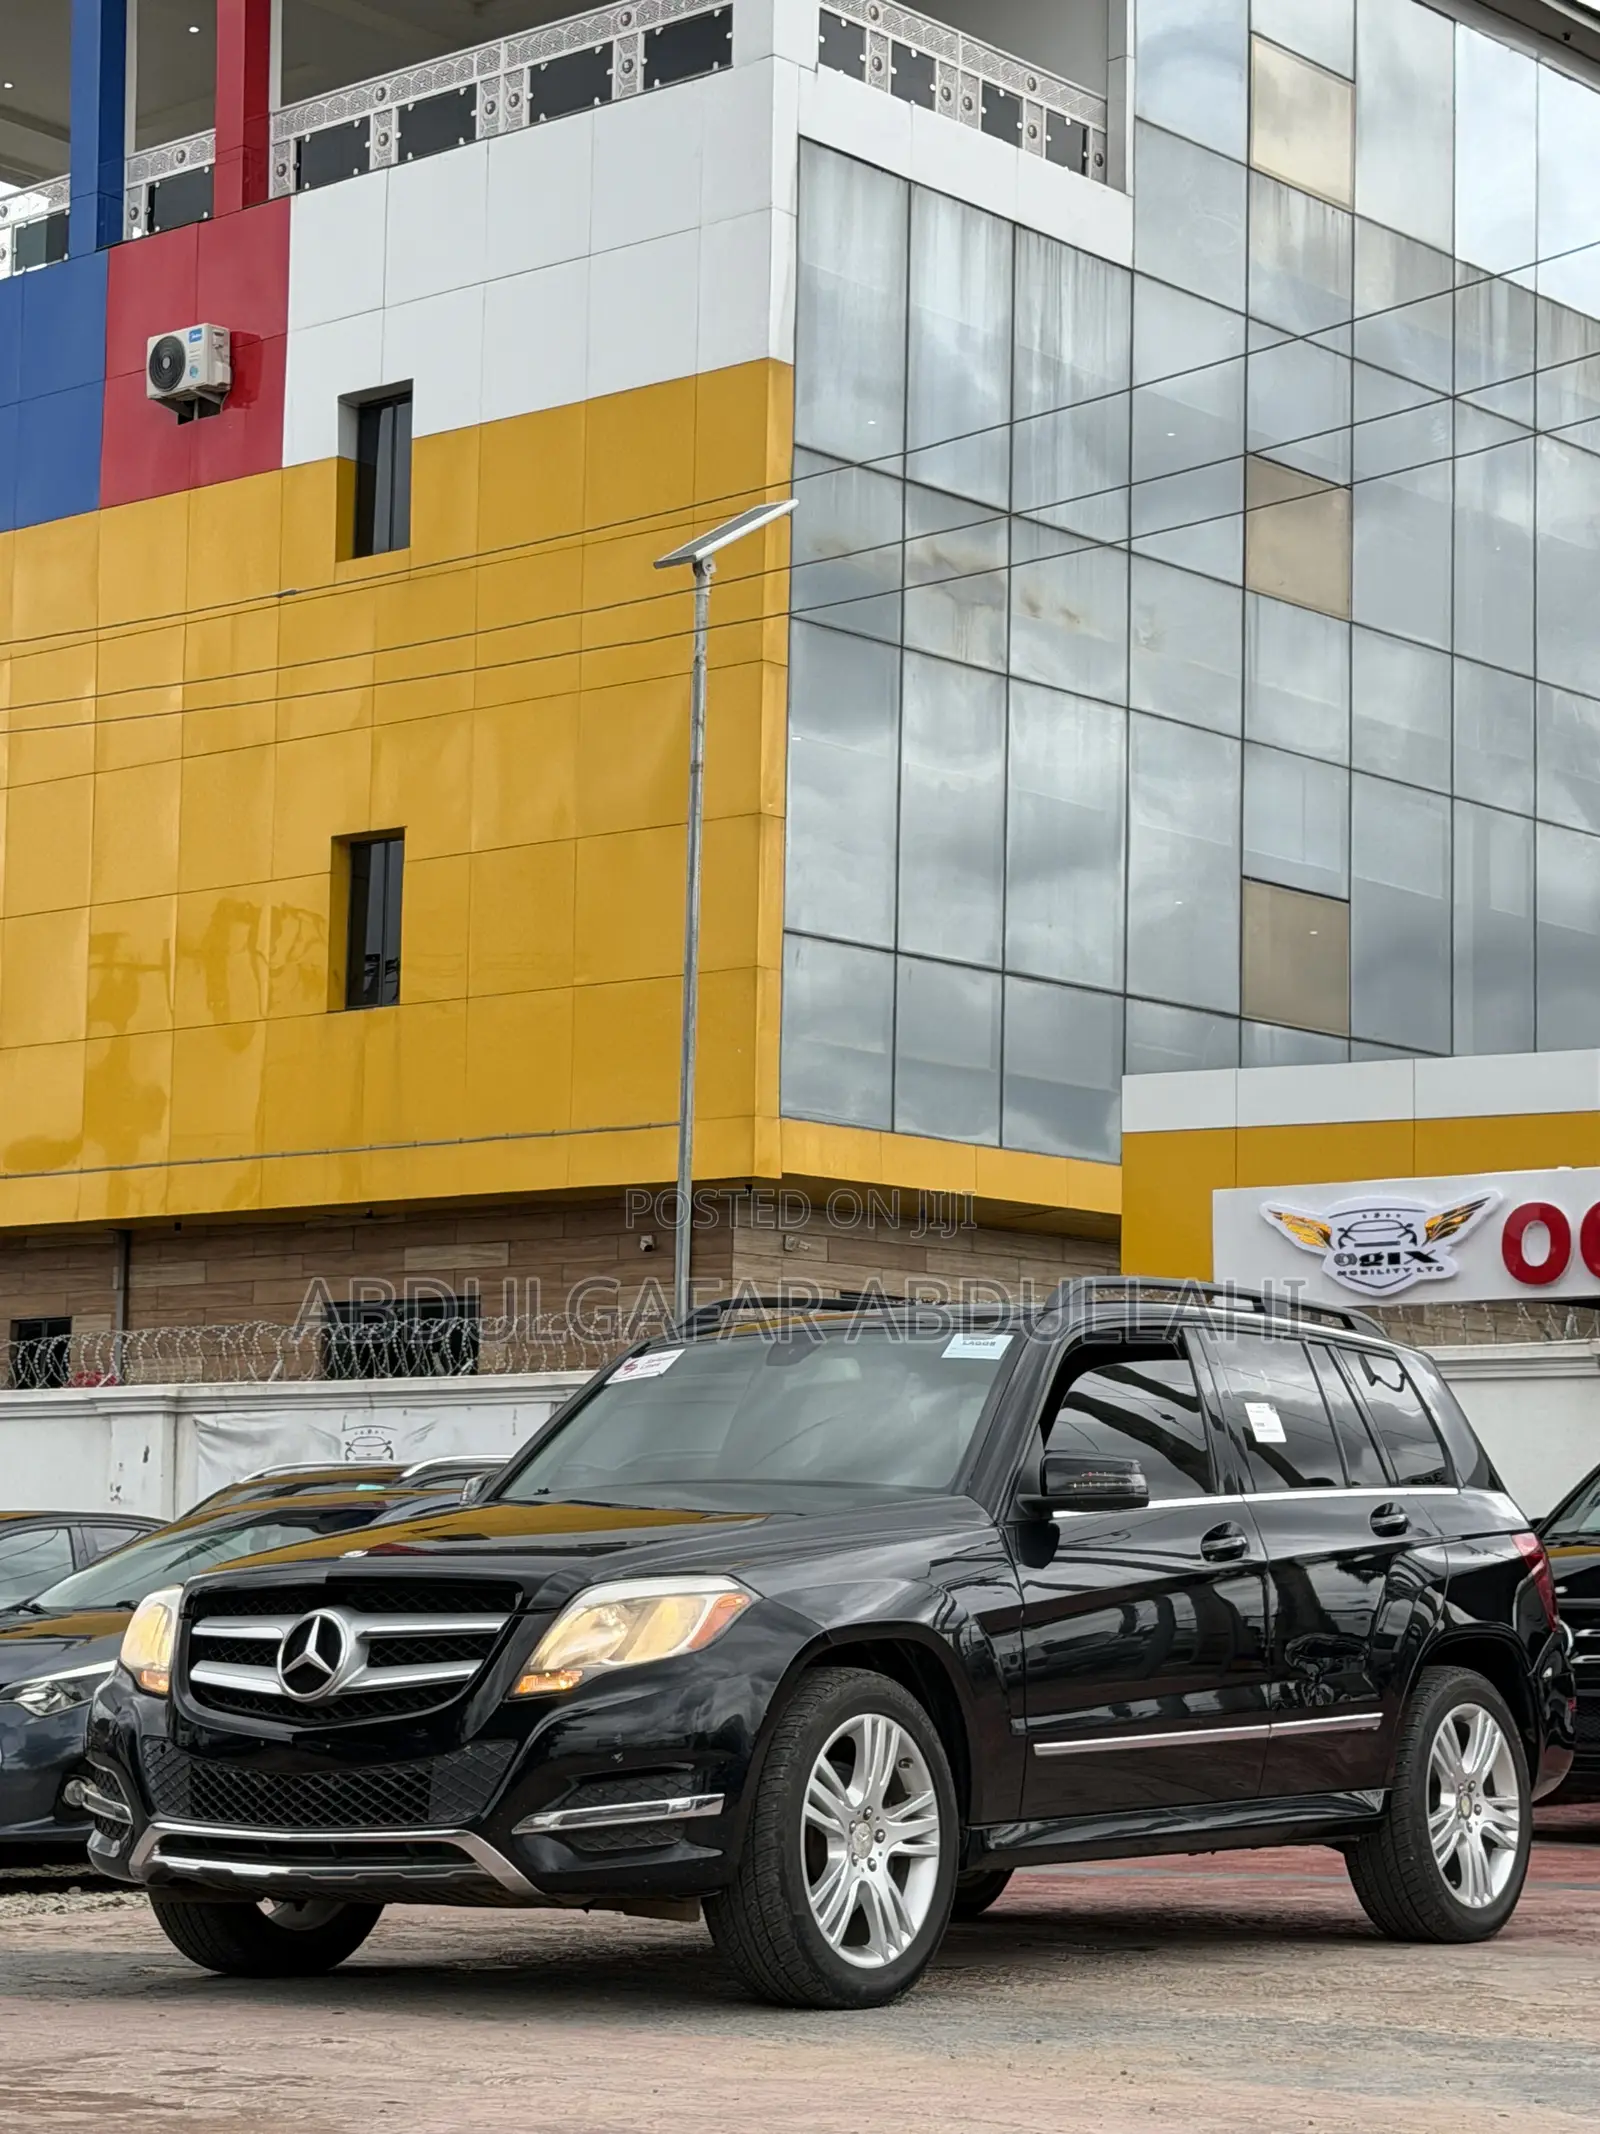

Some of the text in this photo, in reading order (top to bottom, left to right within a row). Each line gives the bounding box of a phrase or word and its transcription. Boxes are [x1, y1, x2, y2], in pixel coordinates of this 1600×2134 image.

[1501, 1201, 1600, 1286] O
[1337, 1265, 1445, 1276] MOBILITY LTD
